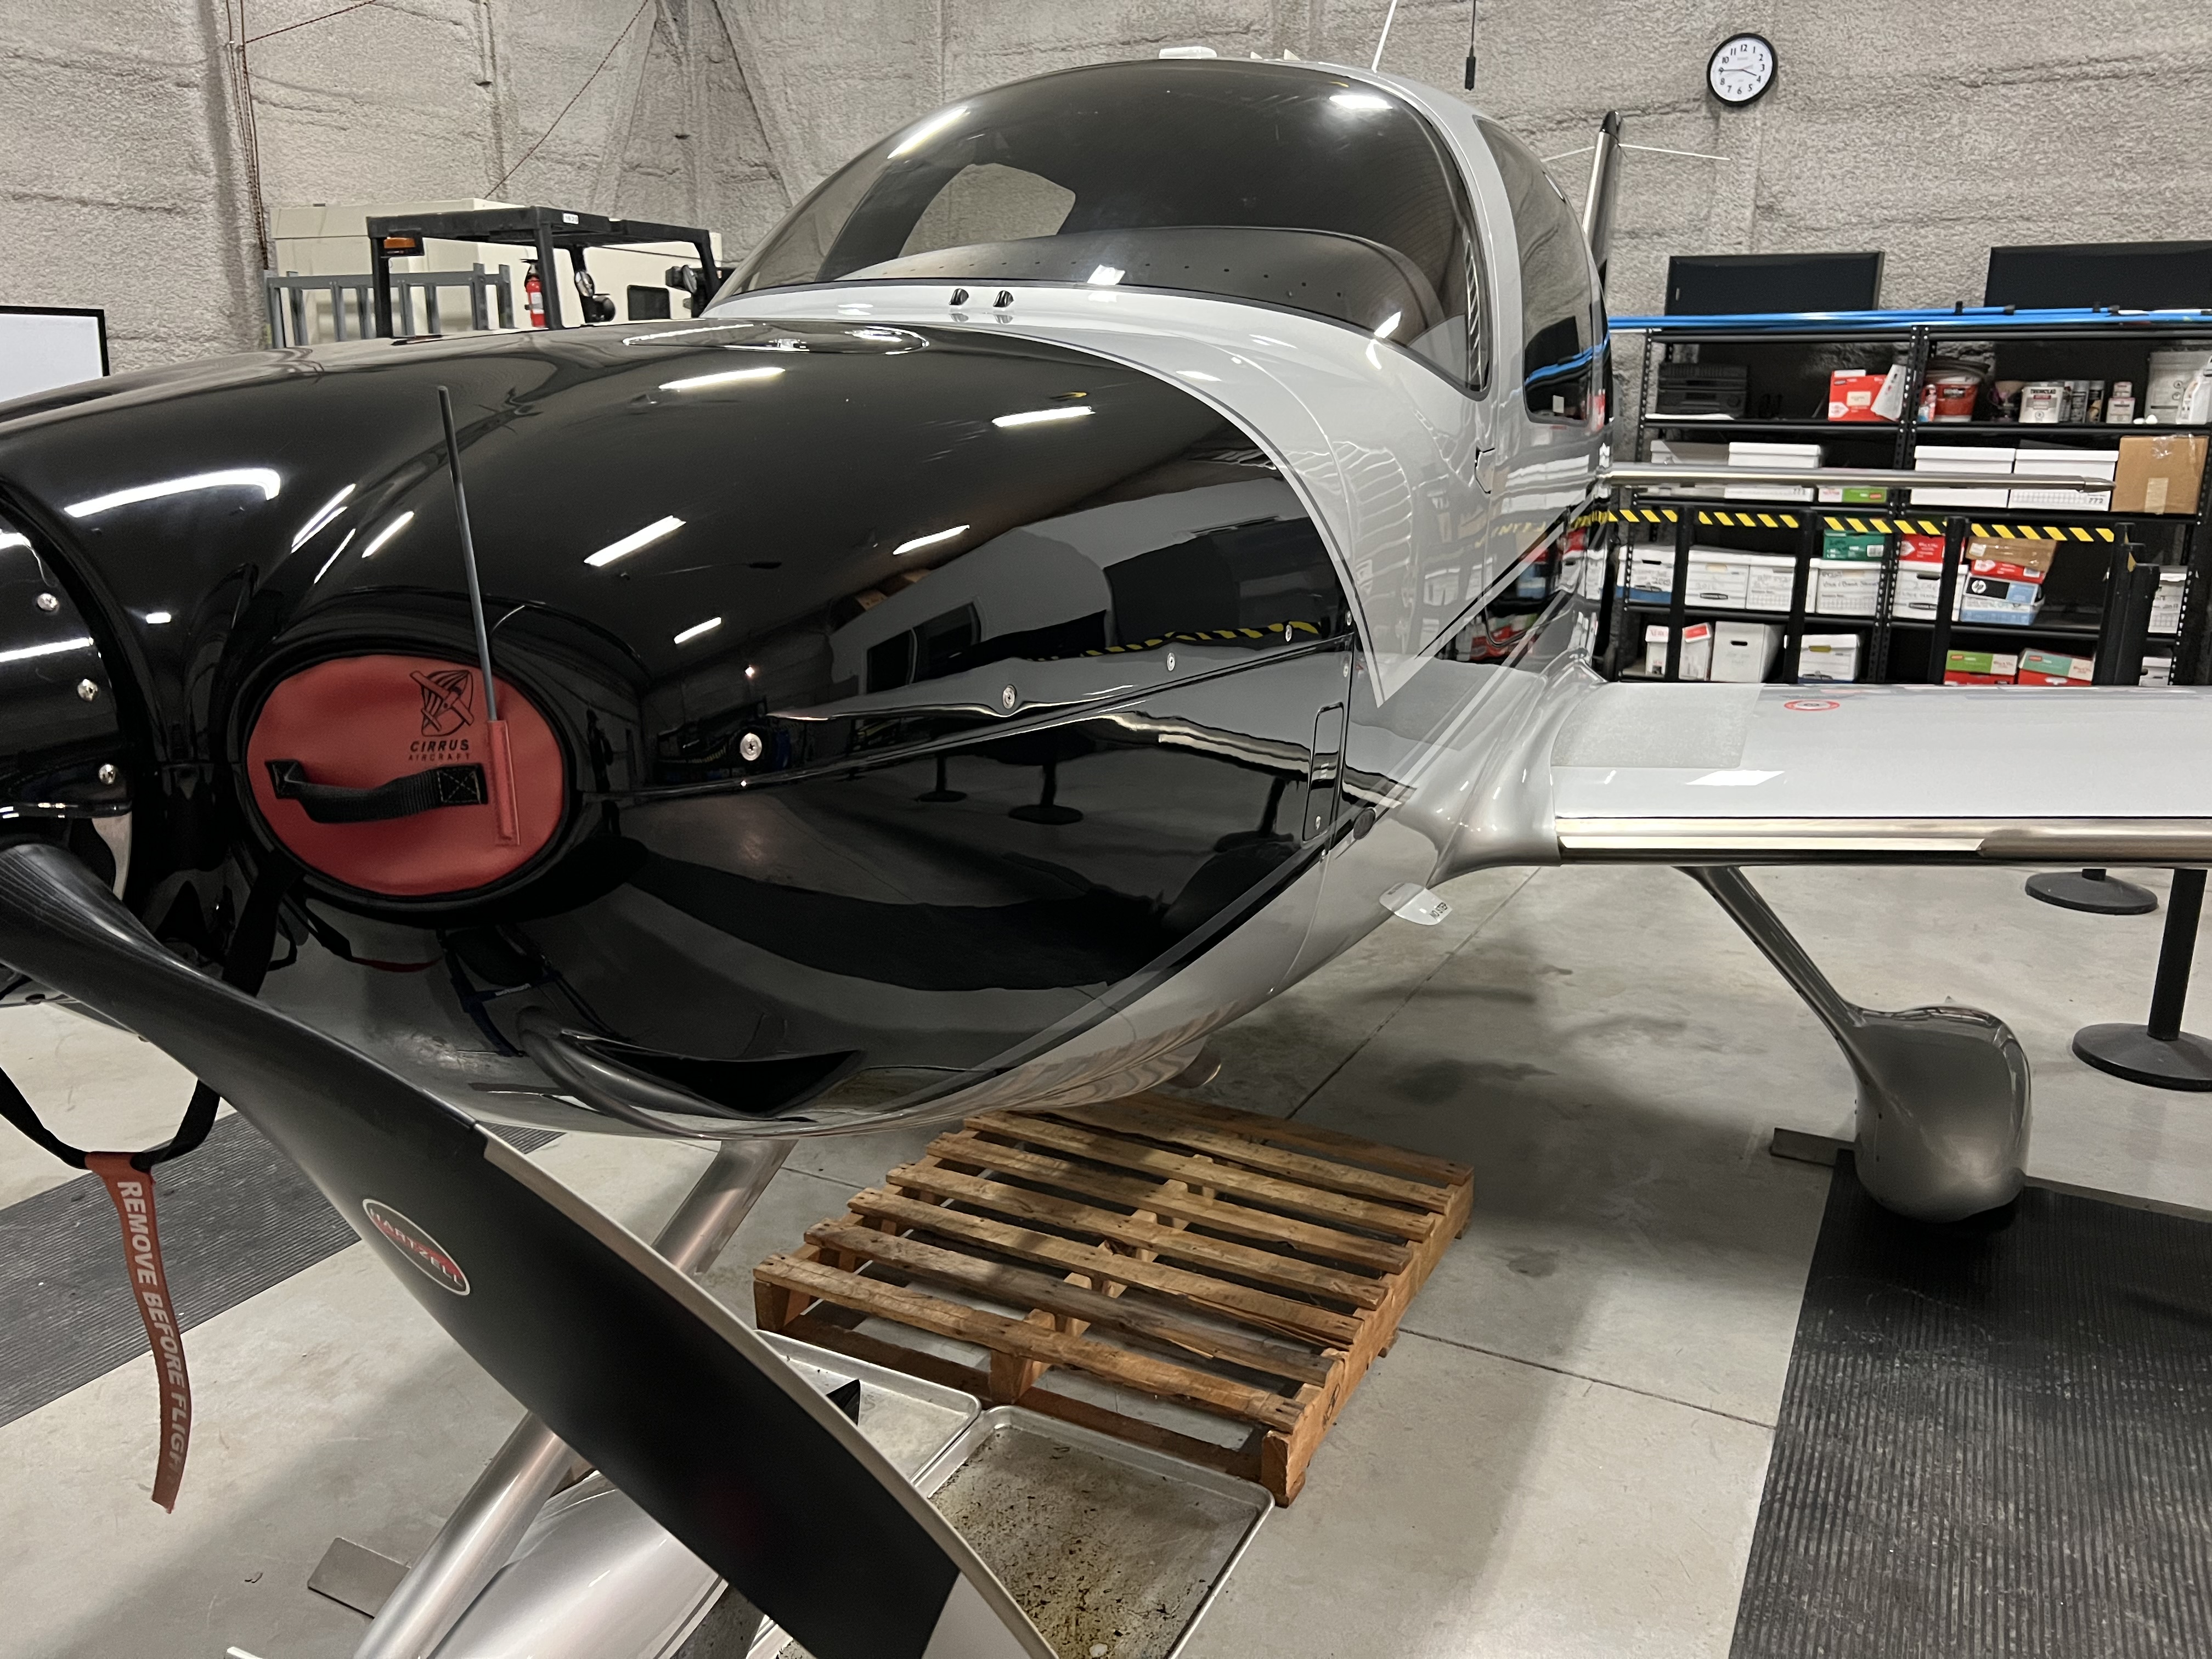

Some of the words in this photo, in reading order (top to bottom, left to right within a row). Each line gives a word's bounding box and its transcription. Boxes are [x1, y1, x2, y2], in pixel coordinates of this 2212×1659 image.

[1730, 48, 1737, 56] 11
[1740, 44, 1747, 52] 12
[1760, 64, 1765, 72] 3
[1720, 77, 1725, 86] 8
[1757, 75, 1761, 83] 4
[1748, 83, 1753, 92] 5
[410, 739, 470, 752] CIRRUS
[408, 752, 470, 761] AIRCRAFT
[369, 1208, 463, 1288] HARTZELL
[117, 1182, 158, 1287] REMOVE
[142, 1291, 185, 1389] BEFORE
